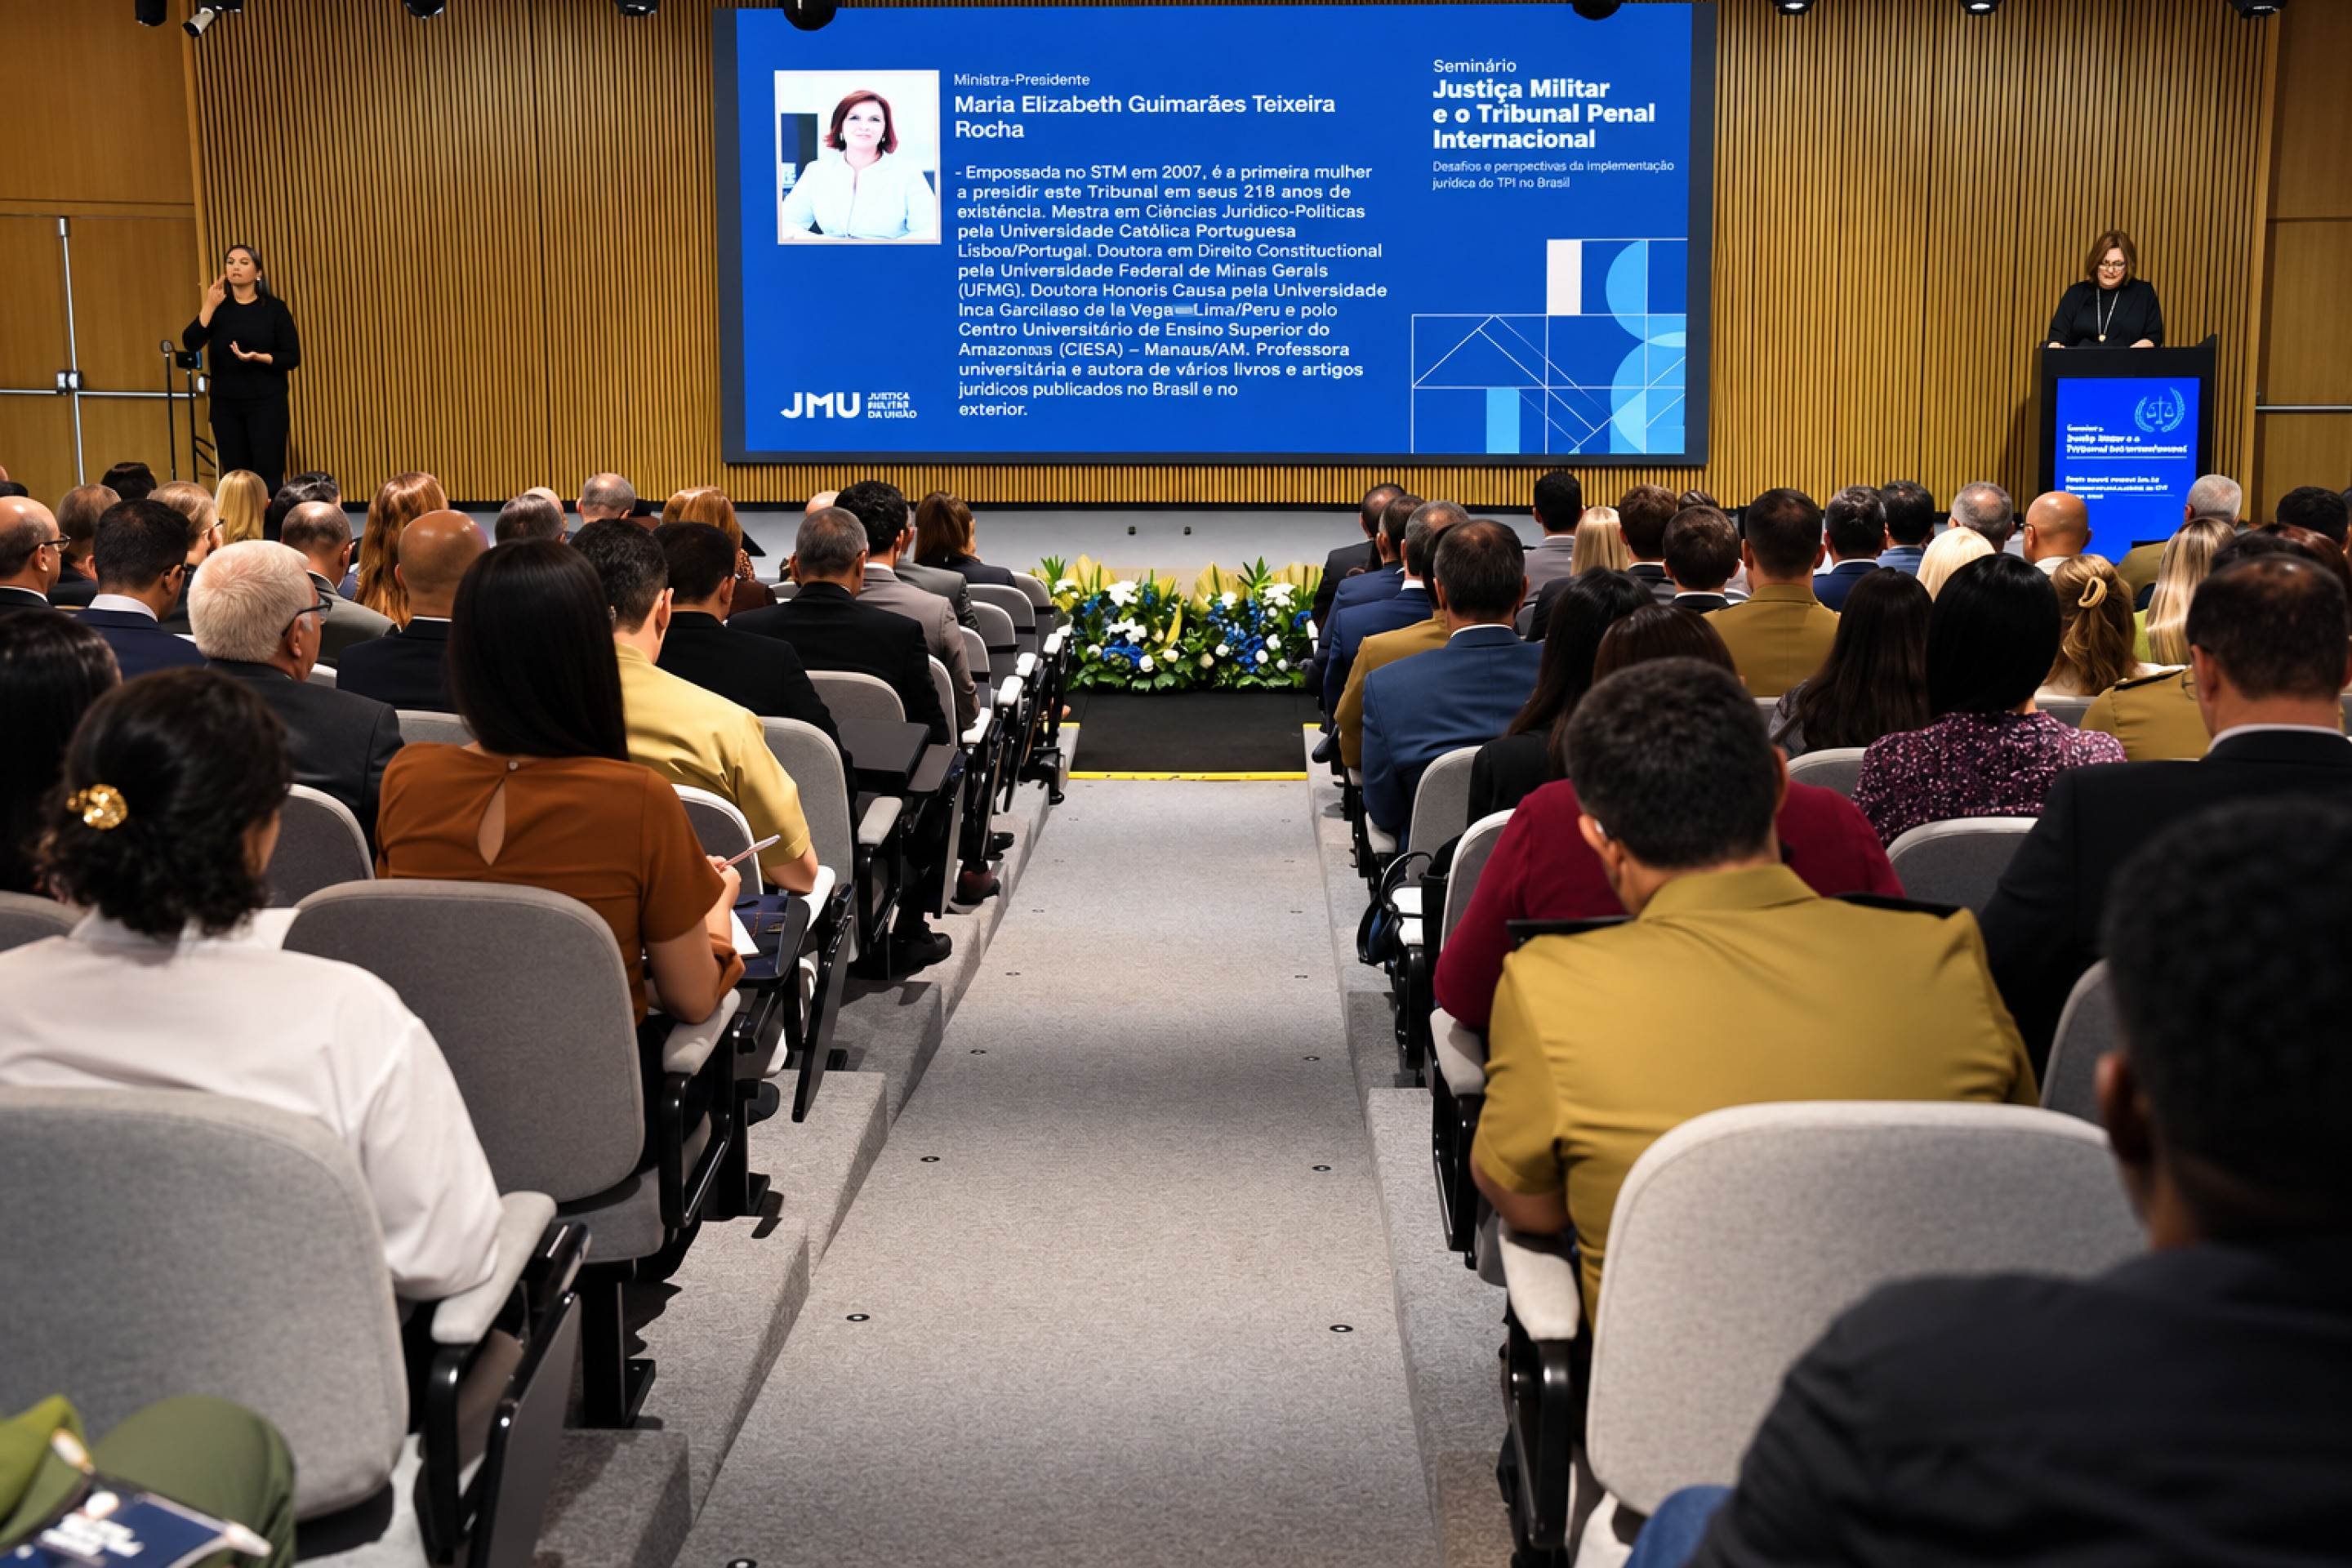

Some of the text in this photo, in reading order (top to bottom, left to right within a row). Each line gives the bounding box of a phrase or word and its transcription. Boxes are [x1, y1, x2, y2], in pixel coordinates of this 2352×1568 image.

[1432, 58, 1517, 73] Seminário
[953, 73, 1091, 87] Ministra-Presidente
[1432, 78, 1610, 104] Justiça Militar
[955, 94, 1336, 113] Maria Elizabeth Guimarães Teixeira
[1432, 102, 1656, 123] e o Tribunal Penal
[955, 120, 1025, 139] Rocha
[1432, 128, 1596, 149] Internacional
[965, 165, 1061, 183] Empossada
[1065, 167, 1086, 179] no
[1091, 164, 1127, 179] STM
[1131, 167, 1157, 180] em
[1161, 164, 1206, 180] 2007,
[1212, 164, 1223, 179] é
[1226, 167, 1236, 179] a
[1241, 164, 1310, 181] primeira
[1314, 164, 1373, 179] mulher
[1478, 177, 1494, 188] do
[1497, 177, 1516, 188] TPI
[1519, 180, 1535, 188] no
[1537, 177, 1570, 188] Brasil
[956, 184, 1352, 202] a presidir este Tribunal em seus 218 anos de
[1051, 204, 1110, 219] Mestra
[1114, 207, 1140, 219] em
[958, 224, 995, 241] pela
[1000, 223, 1114, 238] Universidade
[1196, 223, 1296, 242] Portuguesa
[958, 243, 1091, 261] Lisboa/Portugal.
[1097, 243, 1163, 258] Doutora
[1167, 246, 1193, 258] em
[1198, 243, 1252, 258] Direito
[958, 262, 1329, 281] pela Universidade Federal de Minas Gerais
[958, 283, 1388, 300] (UFMG). Doutora Honoris Causa pela Universidade
[959, 302, 995, 317] Inca
[999, 302, 1079, 318] Garcilaso
[1084, 302, 1105, 317] de
[1111, 302, 1126, 317] la
[1285, 305, 1297, 318] e
[1301, 302, 1338, 319] polo
[958, 321, 1330, 340] Centro Universitário de Ensino Superior do
[1059, 342, 1124, 359] (CIESA)
[1256, 341, 1350, 356] Professora
[959, 361, 1364, 380] universitária e autora de vários livros e artigos
[1032, 381, 1124, 399] publicados
[1127, 385, 1148, 396] no
[1152, 381, 1198, 396] Brasil
[1202, 385, 1214, 396] e
[1218, 385, 1238, 396] no
[780, 391, 861, 419] JMU
[959, 402, 1027, 416] exterior.
